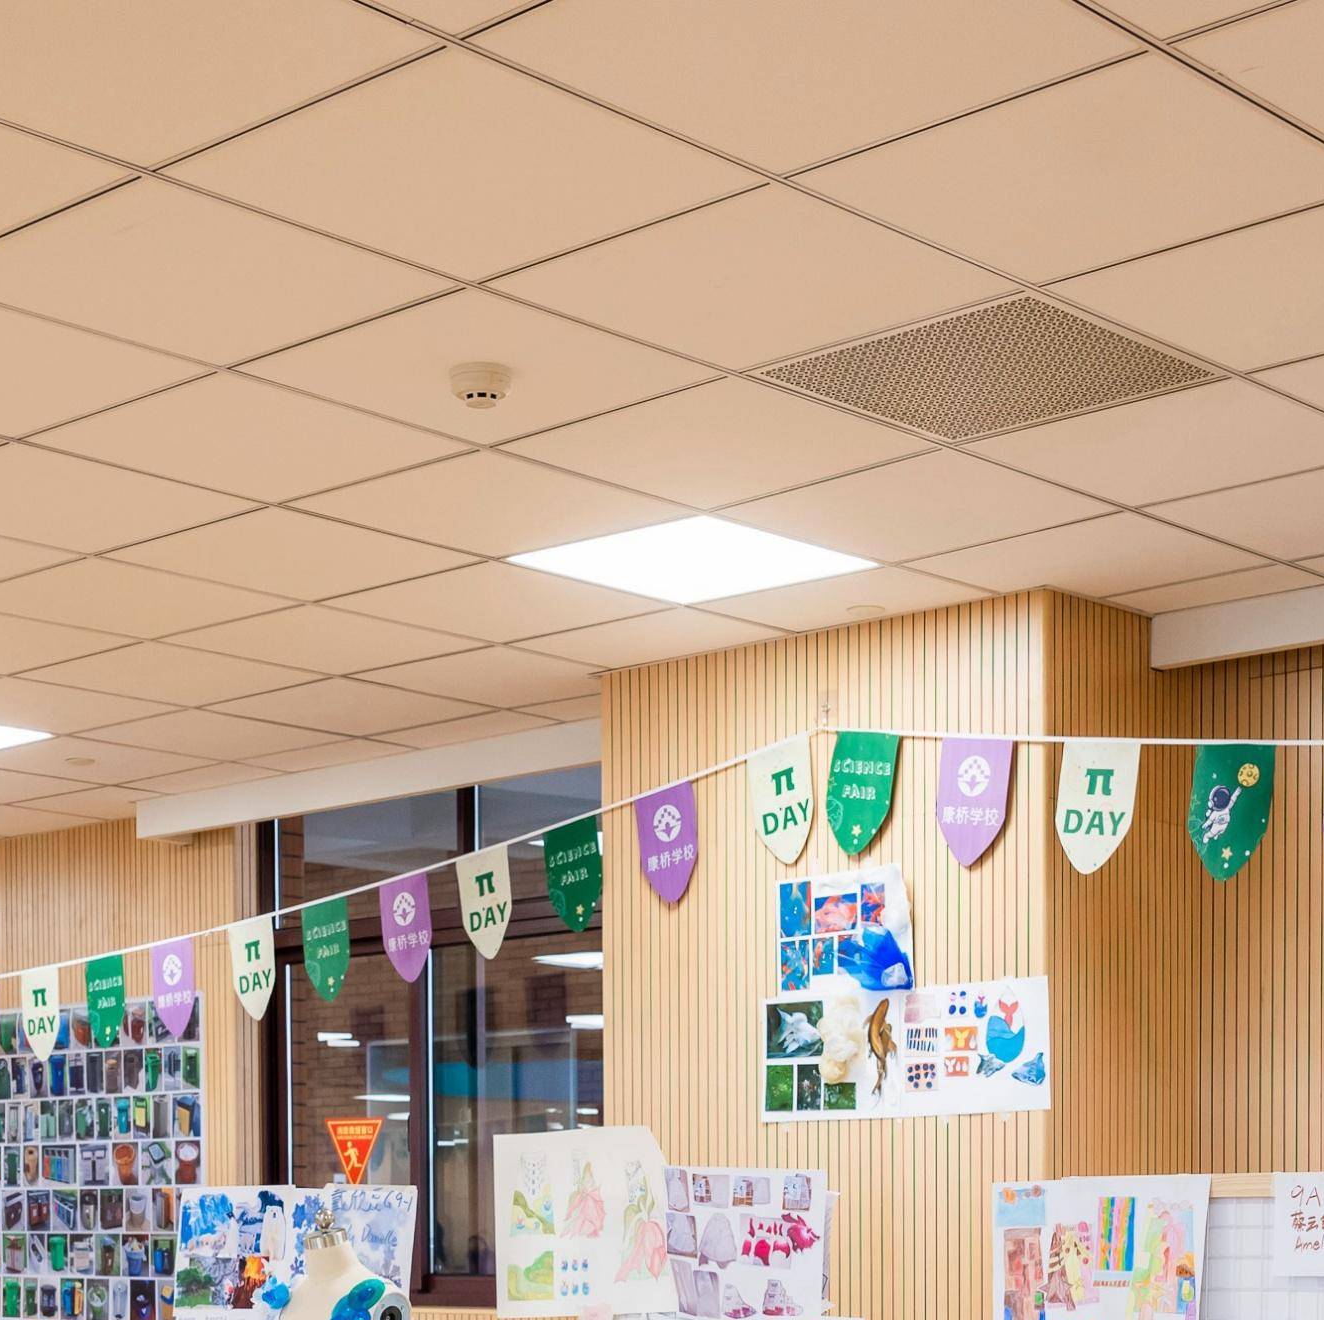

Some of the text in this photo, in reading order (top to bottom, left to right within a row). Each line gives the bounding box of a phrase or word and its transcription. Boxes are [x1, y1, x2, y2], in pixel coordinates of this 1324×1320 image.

[833, 757, 892, 777] SCIENCE
[770, 766, 796, 796] π
[841, 783, 877, 801] FAIR
[1084, 767, 1115, 796] π
[762, 798, 809, 836] DAY
[940, 805, 1000, 827] 康桥学校
[1063, 808, 1126, 837] DAY
[548, 841, 598, 869] SCIENCE
[647, 844, 695, 873] 康桥学校
[474, 870, 495, 897] π
[560, 867, 589, 887] FAIR
[469, 900, 508, 933] DAY
[244, 939, 261, 963] π
[316, 943, 340, 960] FAIR
[238, 968, 272, 996] DAY
[32, 987, 48, 1008] π
[27, 1015, 56, 1036] DAY
[1290, 1184, 1321, 1207] 9A
